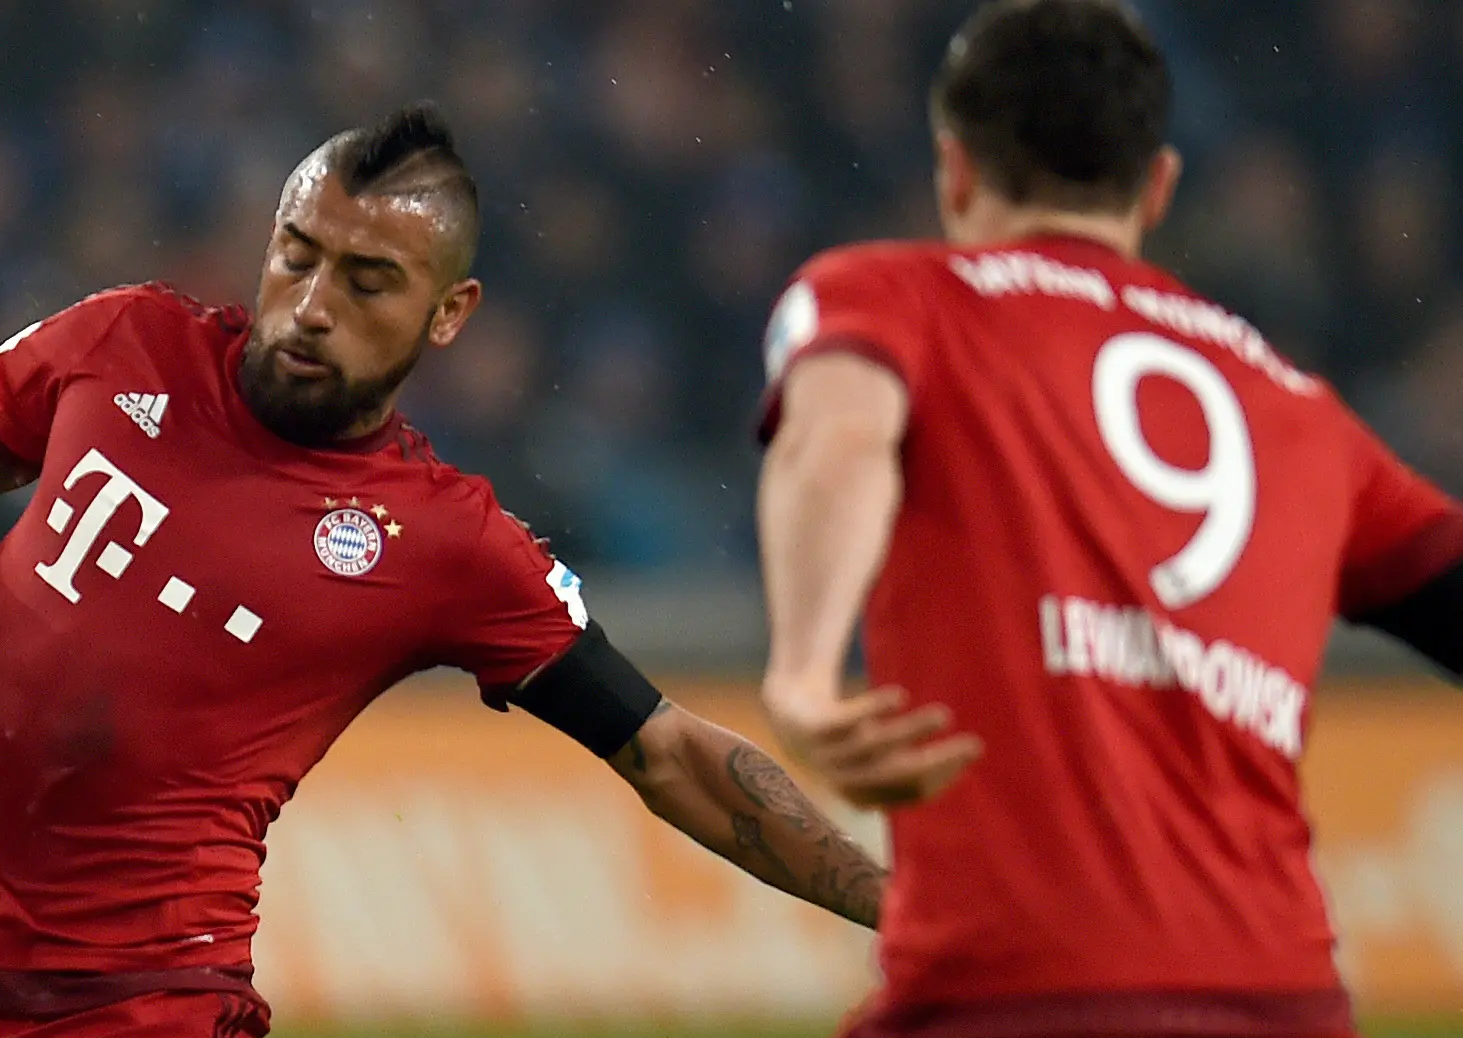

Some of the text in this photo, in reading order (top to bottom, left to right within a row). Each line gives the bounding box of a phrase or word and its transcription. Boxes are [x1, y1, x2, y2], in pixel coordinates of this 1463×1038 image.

[113, 393, 160, 438] adidas
[1092, 330, 1257, 610] 9
[343, 513, 377, 551] BAYERN
